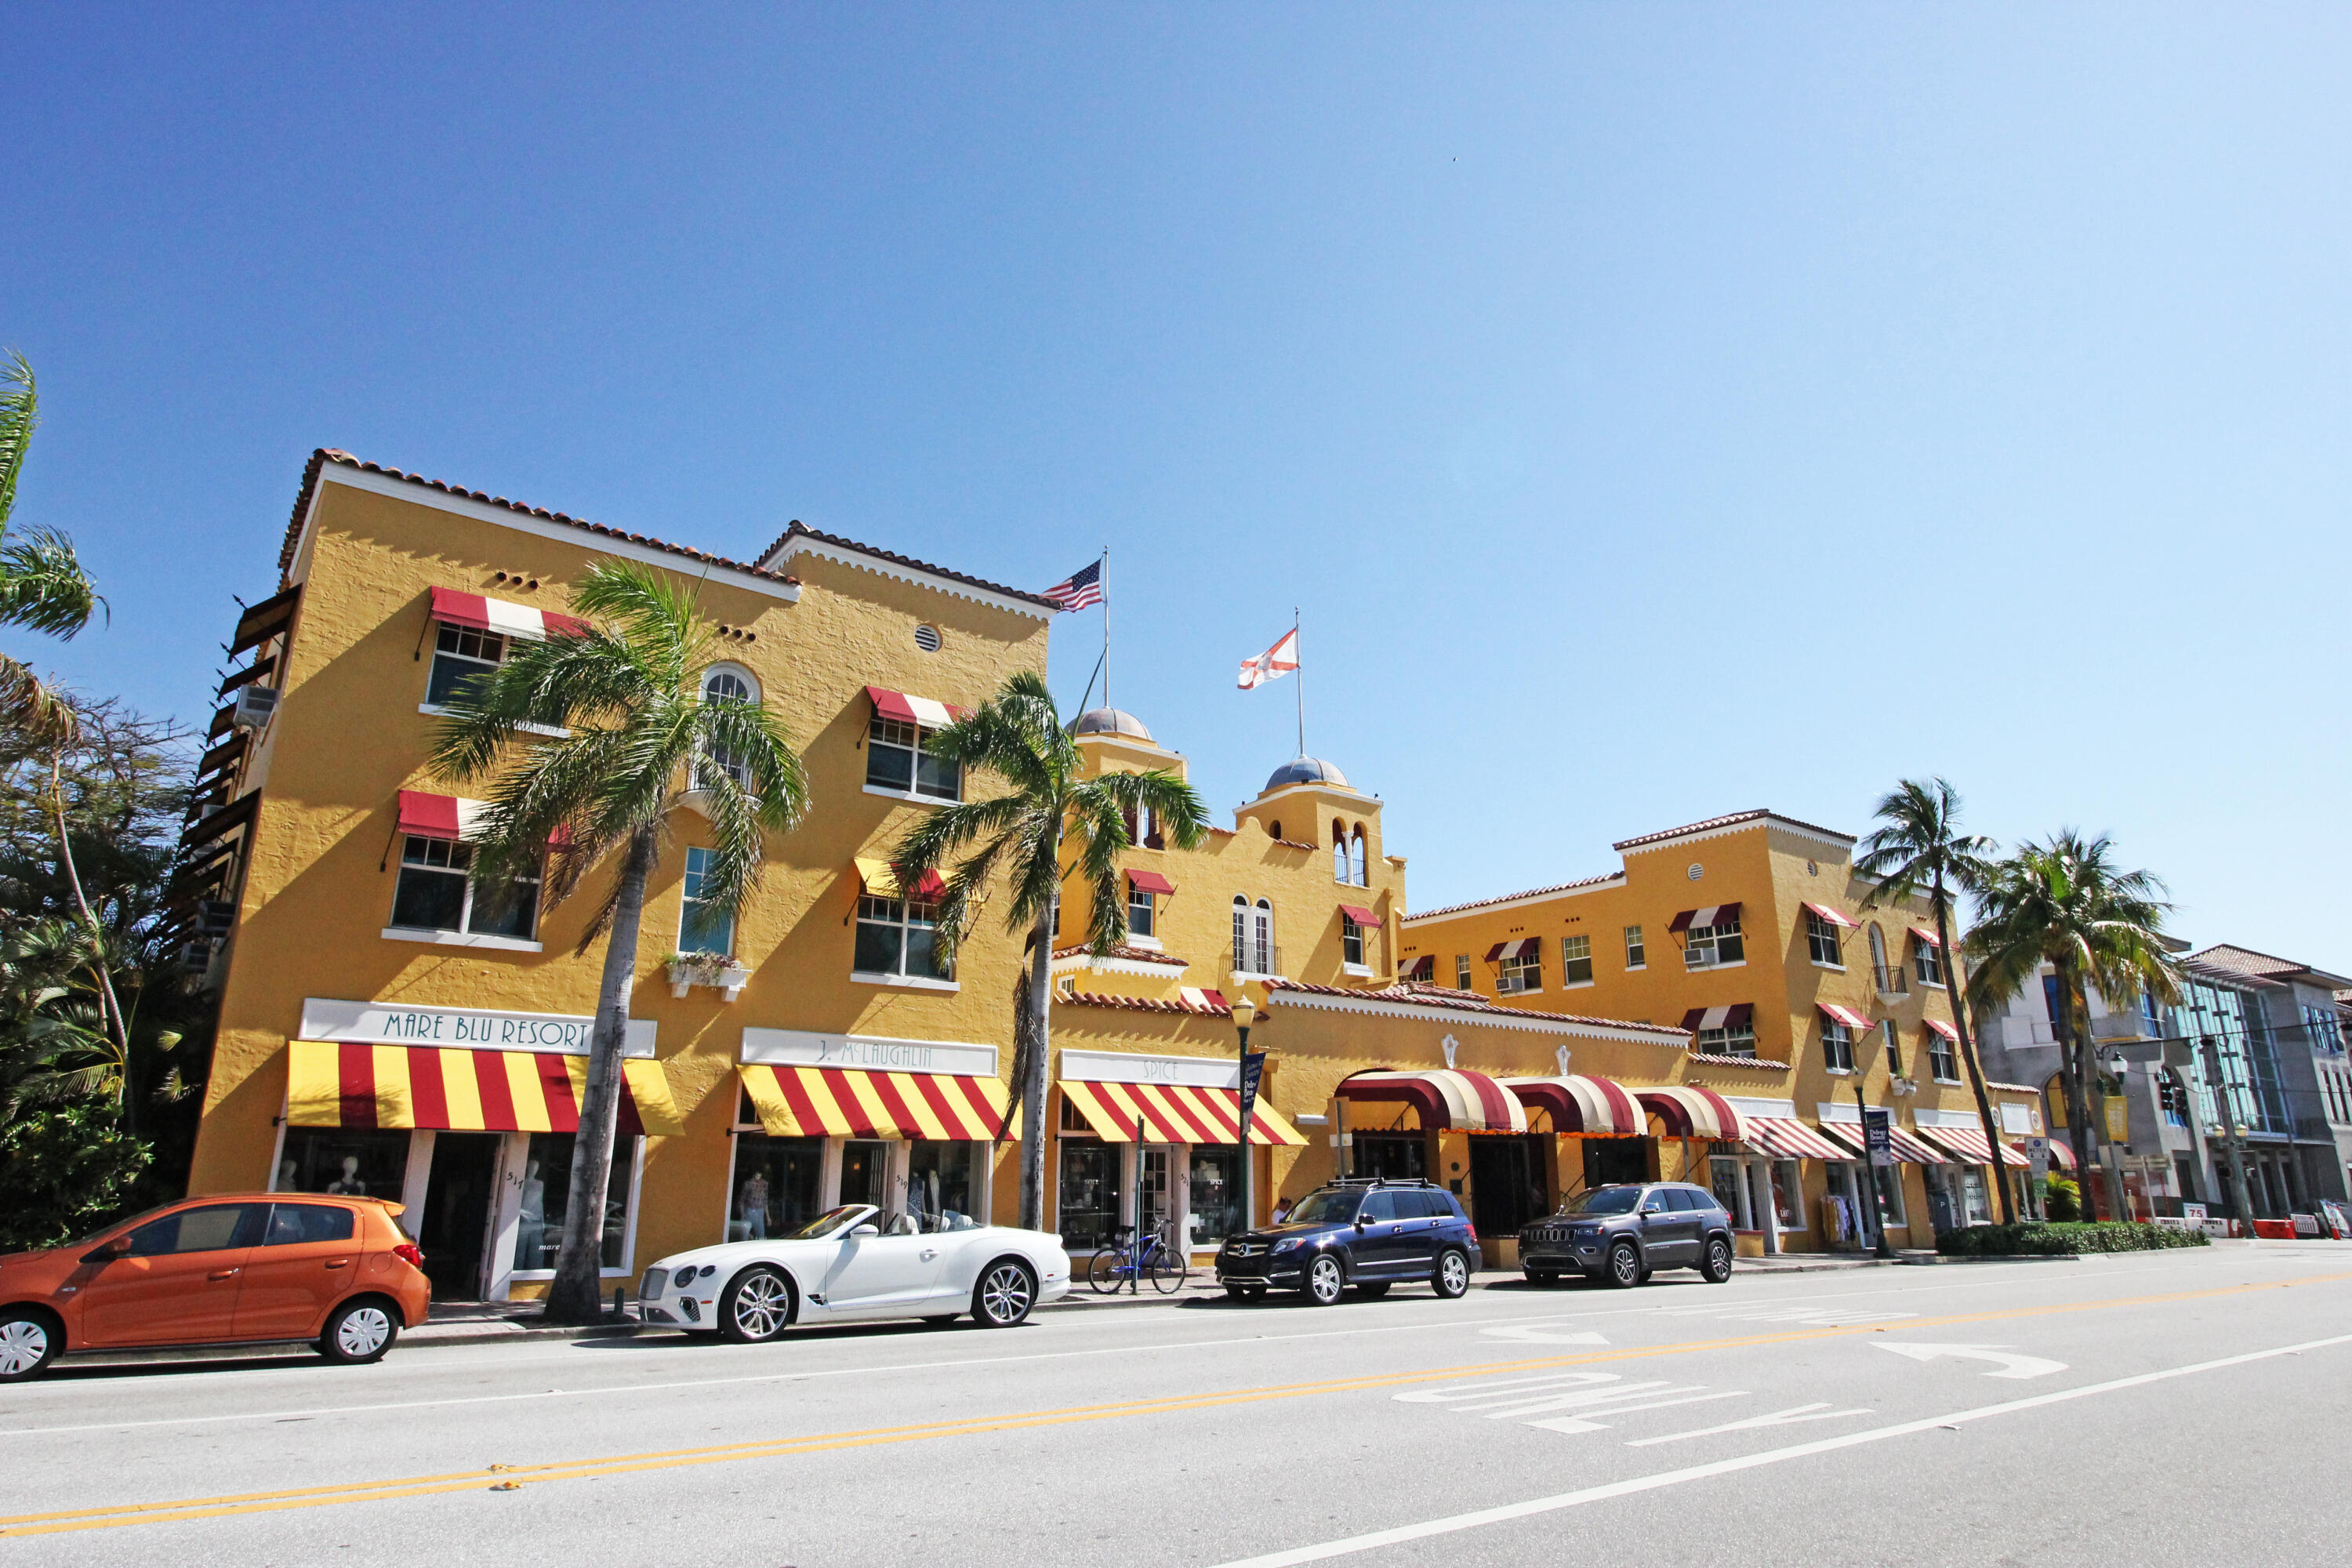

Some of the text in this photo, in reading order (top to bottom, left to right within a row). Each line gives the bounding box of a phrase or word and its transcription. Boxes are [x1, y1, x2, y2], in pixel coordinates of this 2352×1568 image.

[383, 1013, 588, 1047] MARE BLU RESORT
[815, 1040, 832, 1063] J.
[1143, 1060, 1179, 1080] SPICE
[506, 1172, 524, 1189] 517
[896, 1174, 908, 1189] 519
[2188, 1209, 2203, 1218] 75
[1390, 1372, 1877, 1447] ONLY
